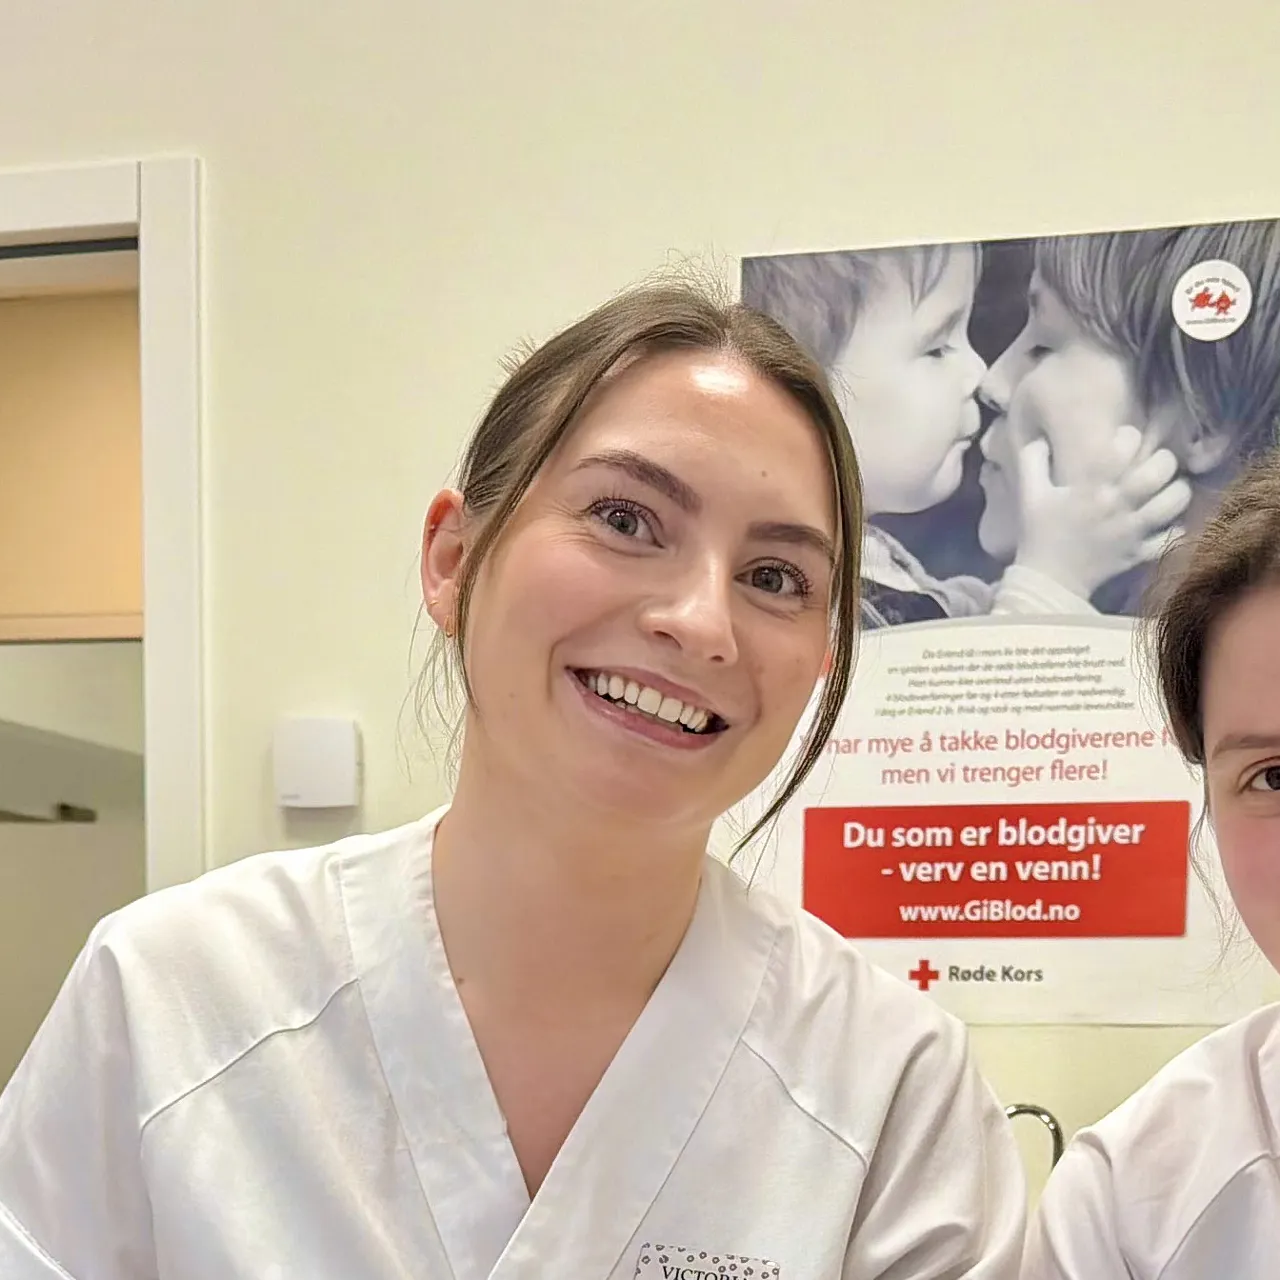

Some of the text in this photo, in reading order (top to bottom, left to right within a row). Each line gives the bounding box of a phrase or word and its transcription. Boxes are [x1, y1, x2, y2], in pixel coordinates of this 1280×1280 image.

[867, 737, 914, 758] mye
[919, 731, 933, 753] å
[939, 730, 999, 752] takke
[1005, 728, 1155, 755] blodgiverene
[881, 758, 1108, 787] men vi trenger flere!
[843, 816, 1146, 853] Du som er blodgiver
[899, 861, 963, 882] verv
[970, 861, 1008, 882] en
[1015, 854, 1101, 881] venn!
[899, 898, 1081, 923] www.GiBlod.no
[947, 963, 1044, 983] Røde Kors
